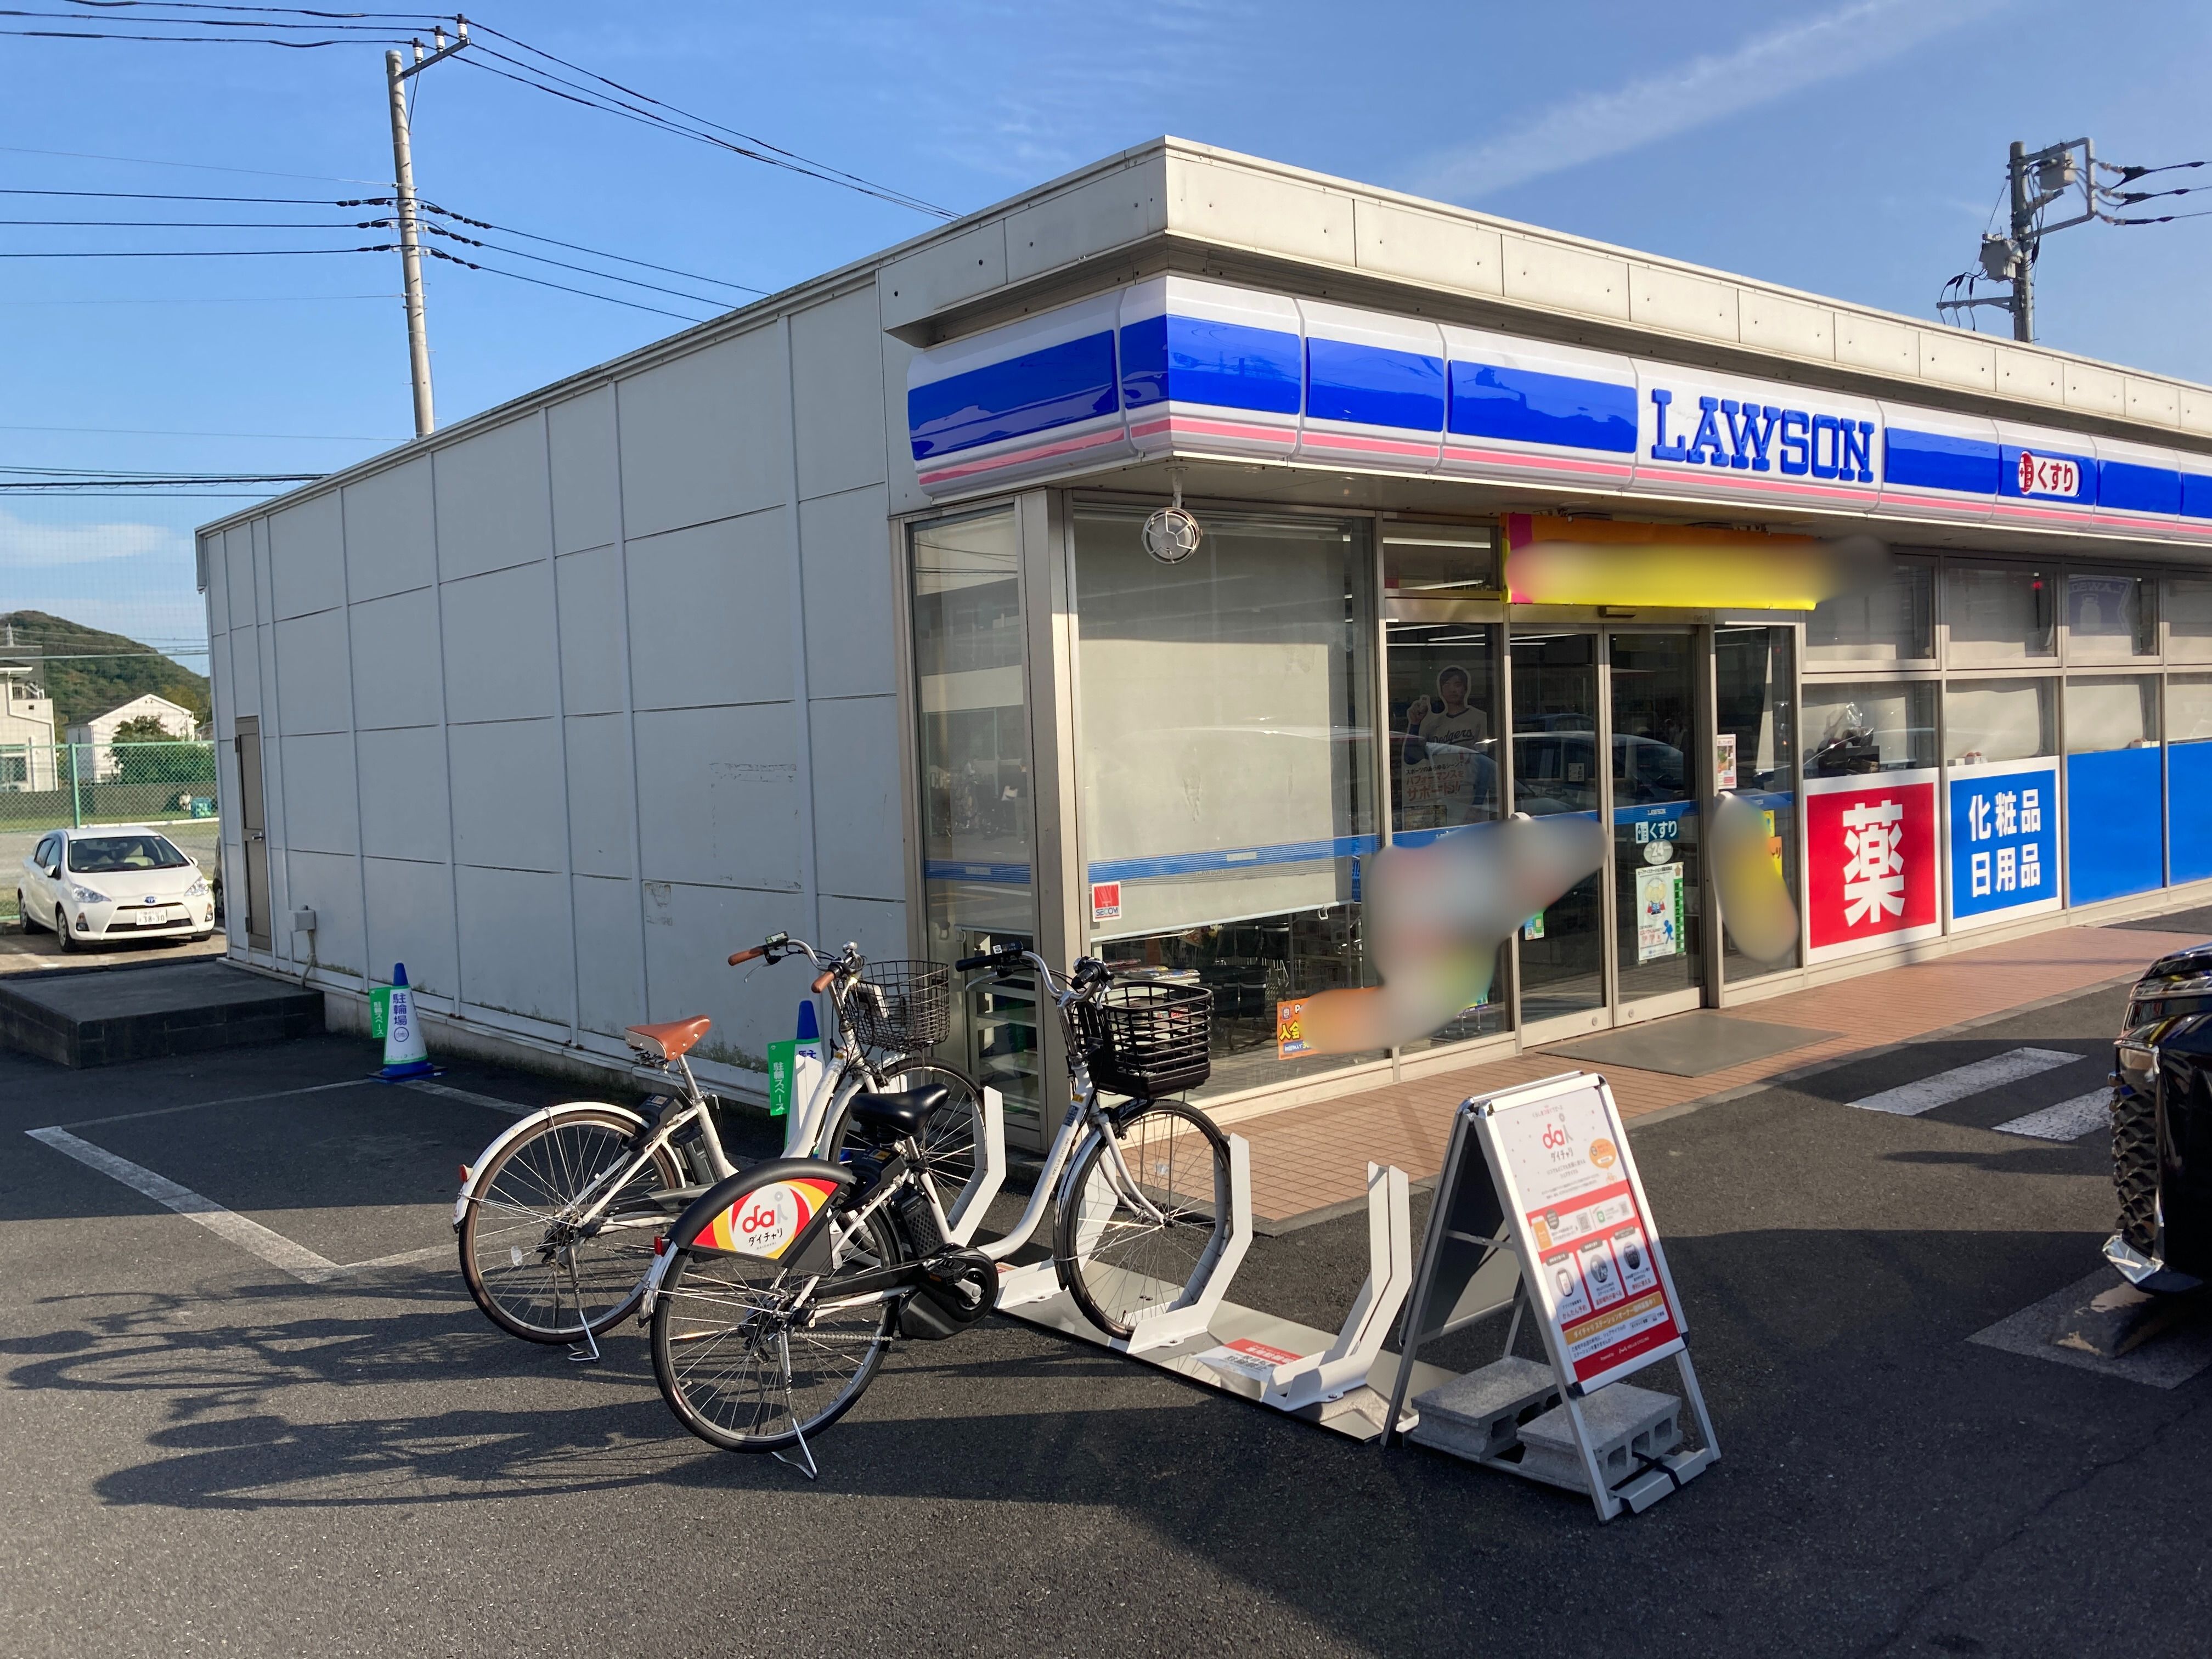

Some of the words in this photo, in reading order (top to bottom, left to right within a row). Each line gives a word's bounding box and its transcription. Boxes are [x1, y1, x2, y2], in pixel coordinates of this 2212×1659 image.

[1651, 388, 1874, 483] LAWSON
[2038, 461, 2073, 492] くすり
[1406, 770, 1465, 785] パフォーマンスを
[1650, 821, 1677, 839] くすり
[1968, 788, 2041, 842] 化粧品
[1651, 842, 1664, 856] 24
[1842, 799, 1905, 928] 薬
[1971, 843, 2041, 898] 日用品
[1096, 907, 1119, 916] SECOM
[373, 1001, 384, 1036] 駐輪スペース
[393, 993, 408, 1026] 駐輪場
[773, 1062, 785, 1112] 駐輪スペース
[1542, 1113, 1574, 1149] dai
[1052, 1159, 1061, 1176] HELLO
[1059, 1137, 1070, 1159] CYCLING
[1550, 1147, 1574, 1163] ダイチャリ
[742, 1191, 788, 1233] dai
[748, 1227, 783, 1247] ダイチャリ
